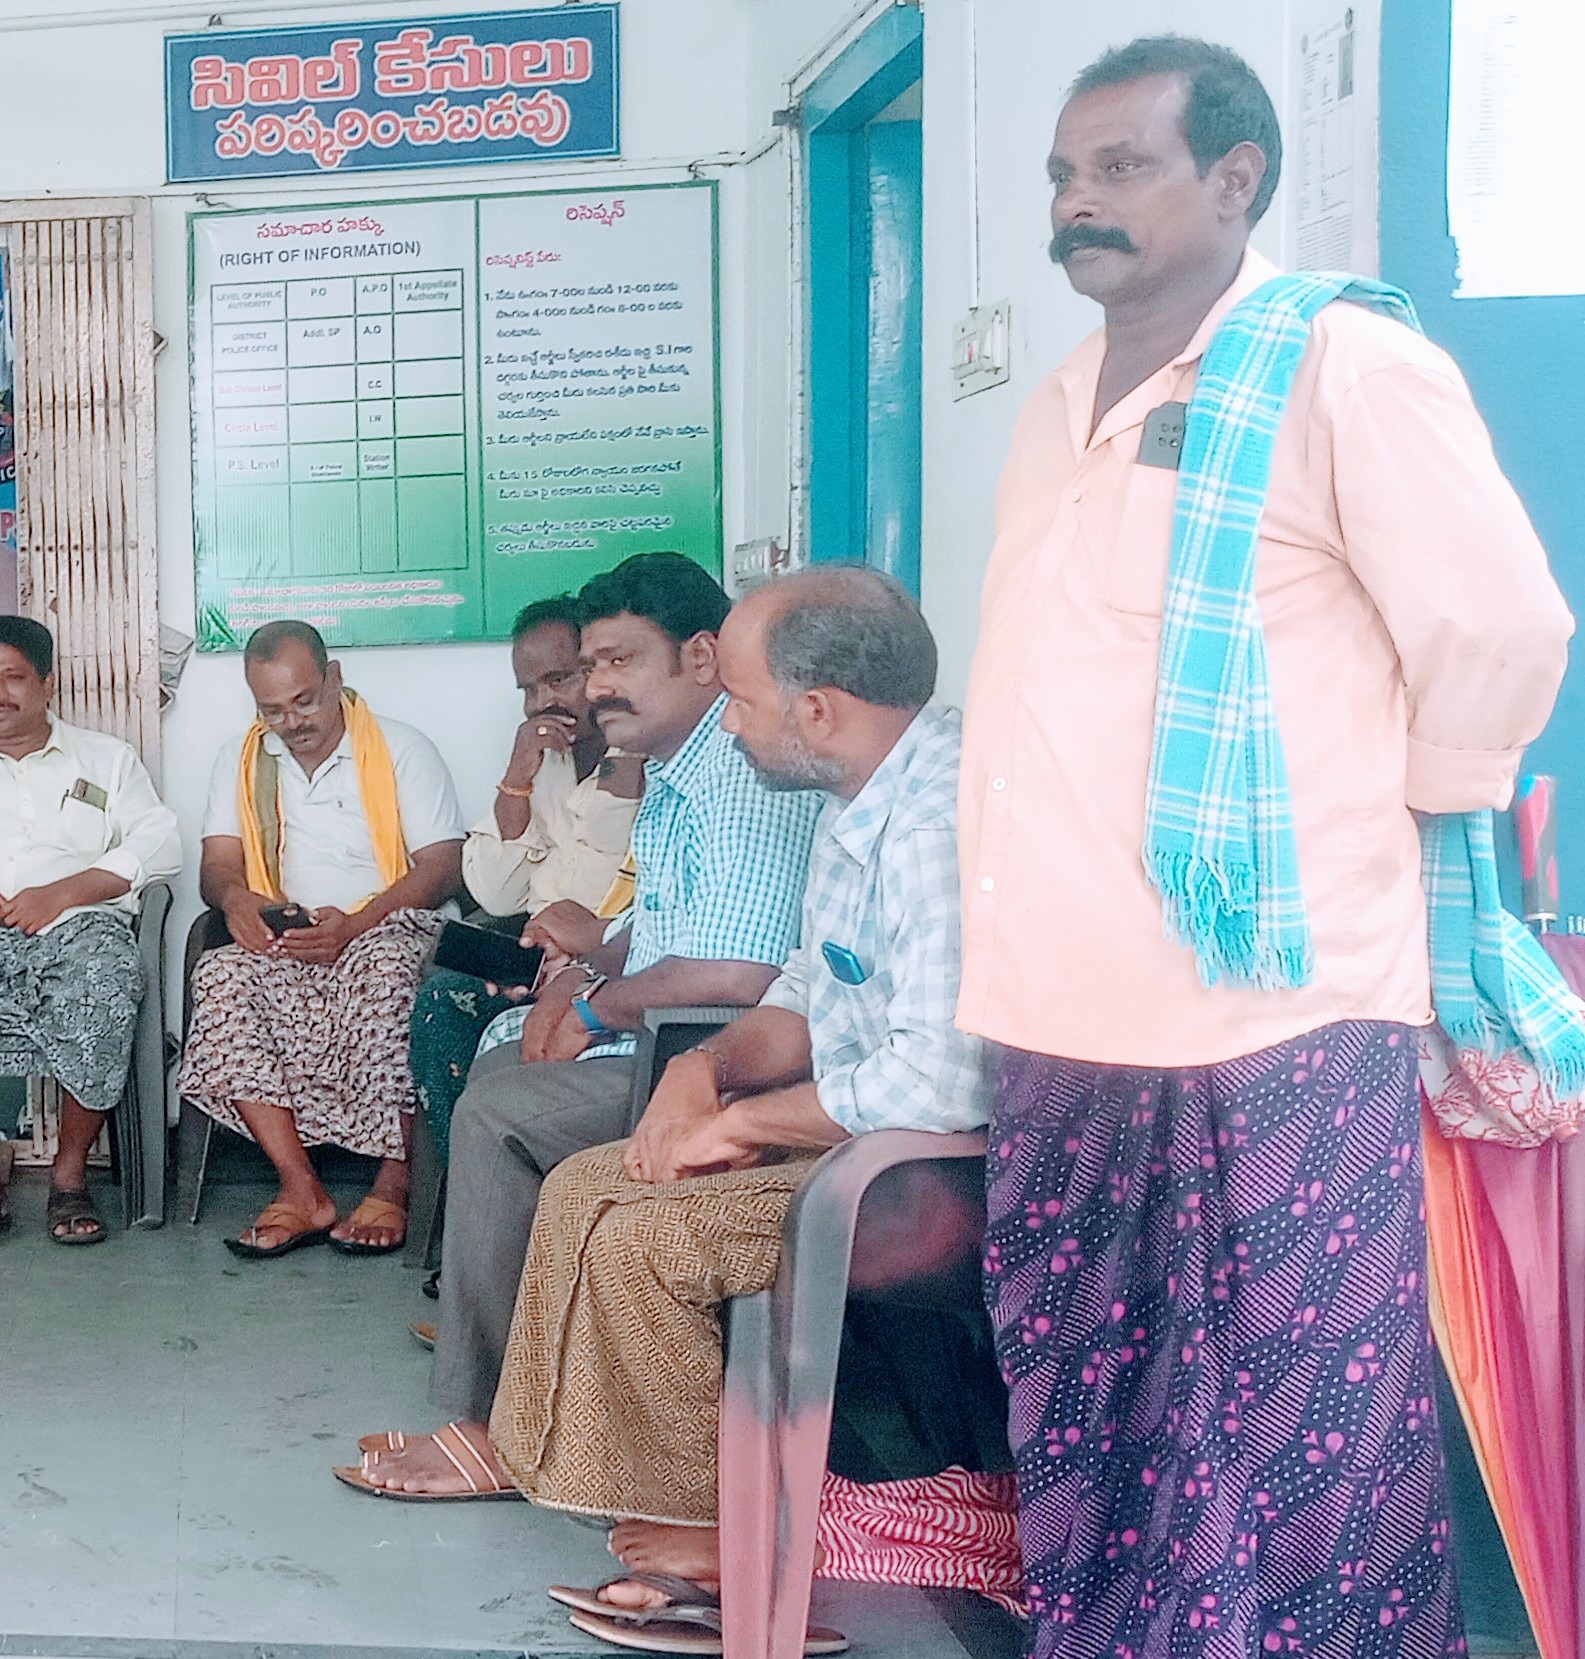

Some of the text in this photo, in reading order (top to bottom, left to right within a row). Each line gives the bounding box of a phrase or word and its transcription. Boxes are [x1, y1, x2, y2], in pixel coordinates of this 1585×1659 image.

[190, 28, 593, 110] సివిల్ కేసులు
[214, 91, 571, 169] పరిష్కరించబడవు
[566, 200, 626, 226] రిసెప్షన్
[257, 216, 385, 239] సమాచార హక్కు
[219, 241, 421, 269] (RIGHT OF INFORMATION)
